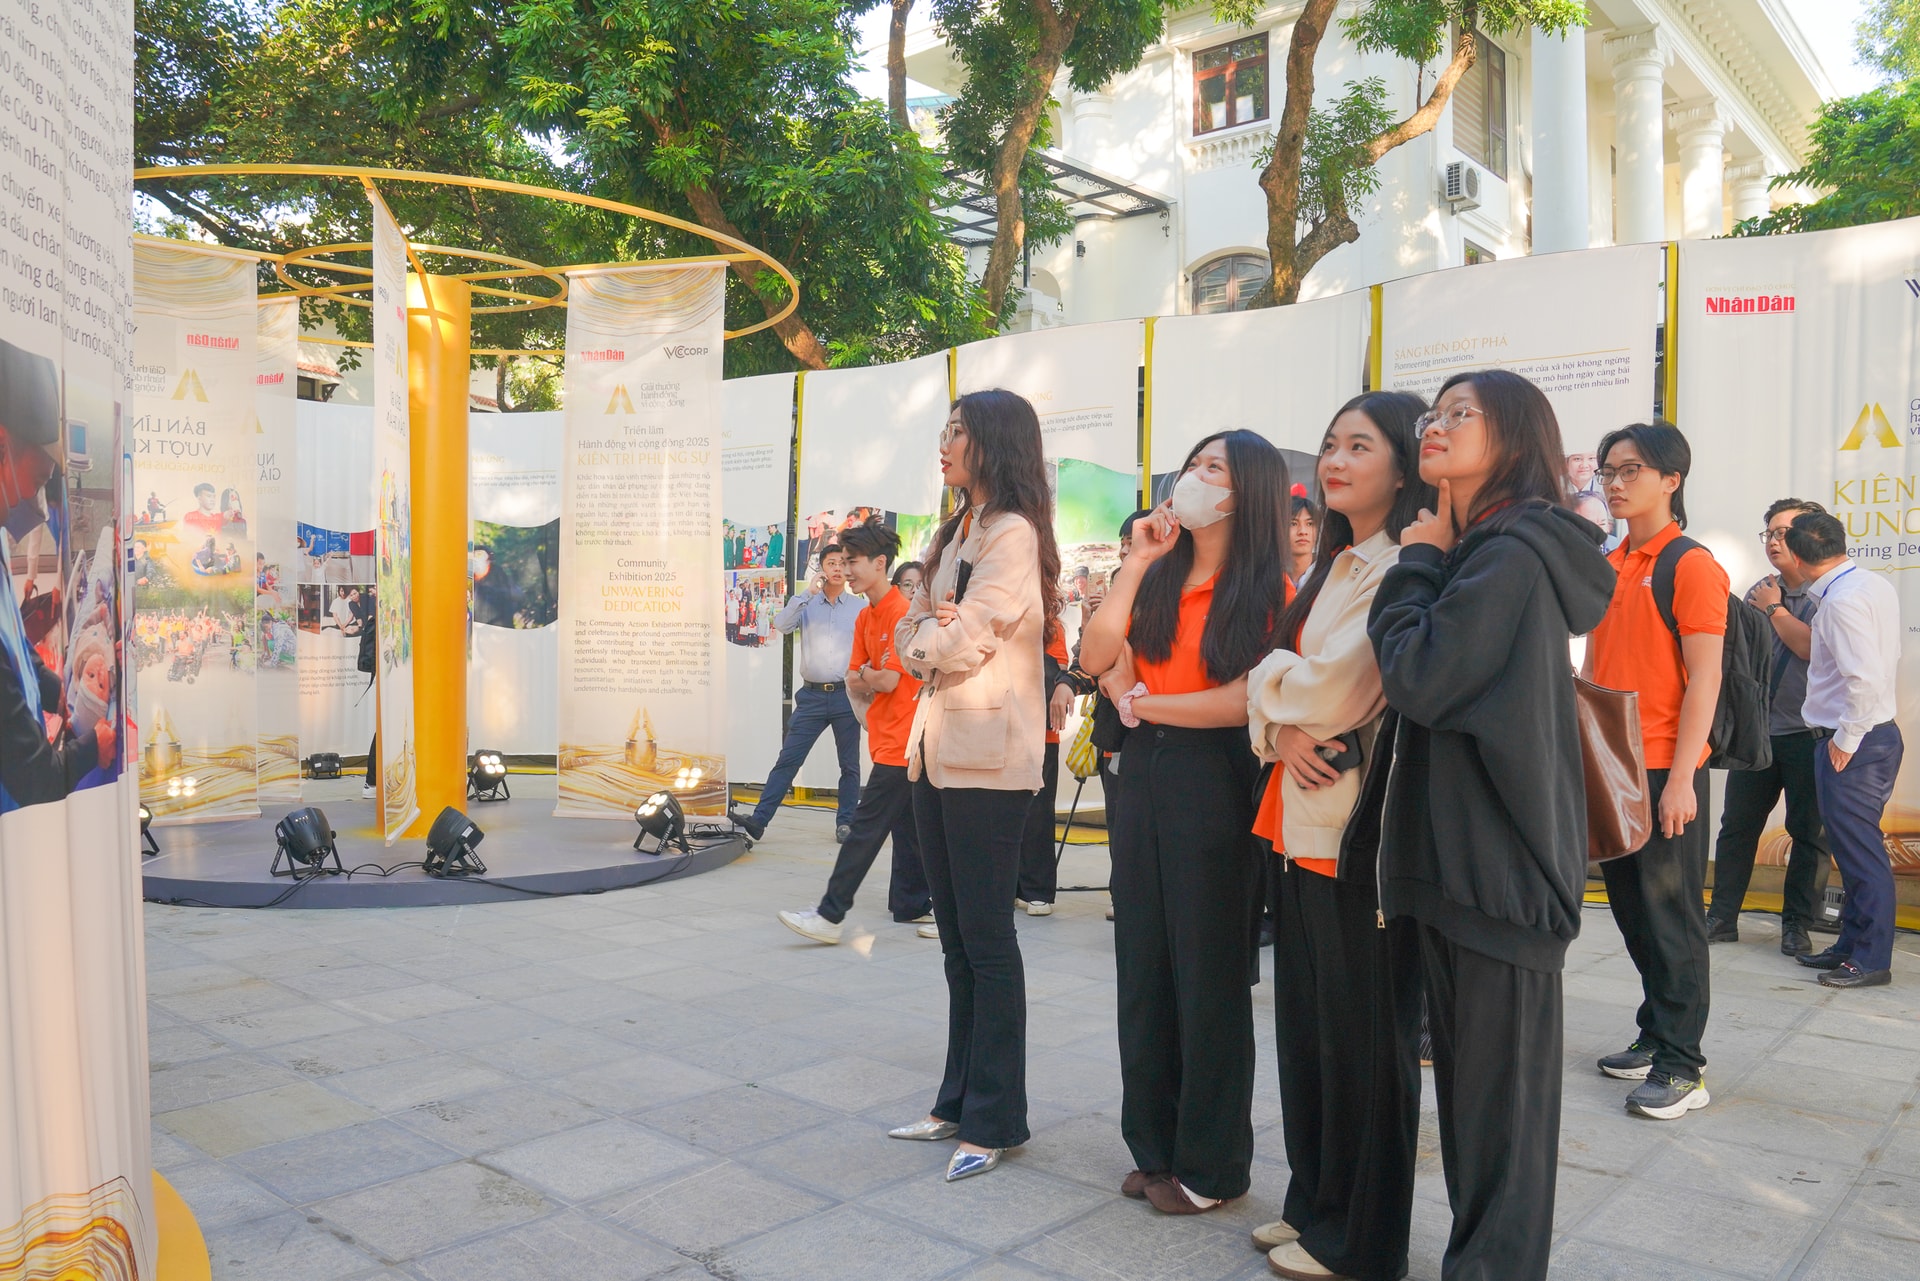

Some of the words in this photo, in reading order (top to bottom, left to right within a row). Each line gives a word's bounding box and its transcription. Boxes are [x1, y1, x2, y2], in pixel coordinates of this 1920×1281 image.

[14, 97, 38, 133] Cứu
[24, 147, 57, 182] nhân
[2, 171, 44, 214] chuyến
[48, 202, 61, 223] xe
[10, 212, 29, 242] dấu
[12, 254, 42, 288] vững
[3, 287, 35, 318] người
[39, 298, 58, 327] lan
[1706, 296, 1754, 312] Nhân
[1758, 295, 1795, 312] Dân
[1432, 354, 1474, 366] innovations
[686, 438, 710, 447] 2025
[1834, 472, 1916, 506] KIÊN
[616, 558, 668, 570] Community
[608, 572, 653, 582] Exhibition
[654, 572, 677, 582] 2025
[601, 586, 684, 598] UNWAVERING
[604, 600, 681, 612] DEDICATION
